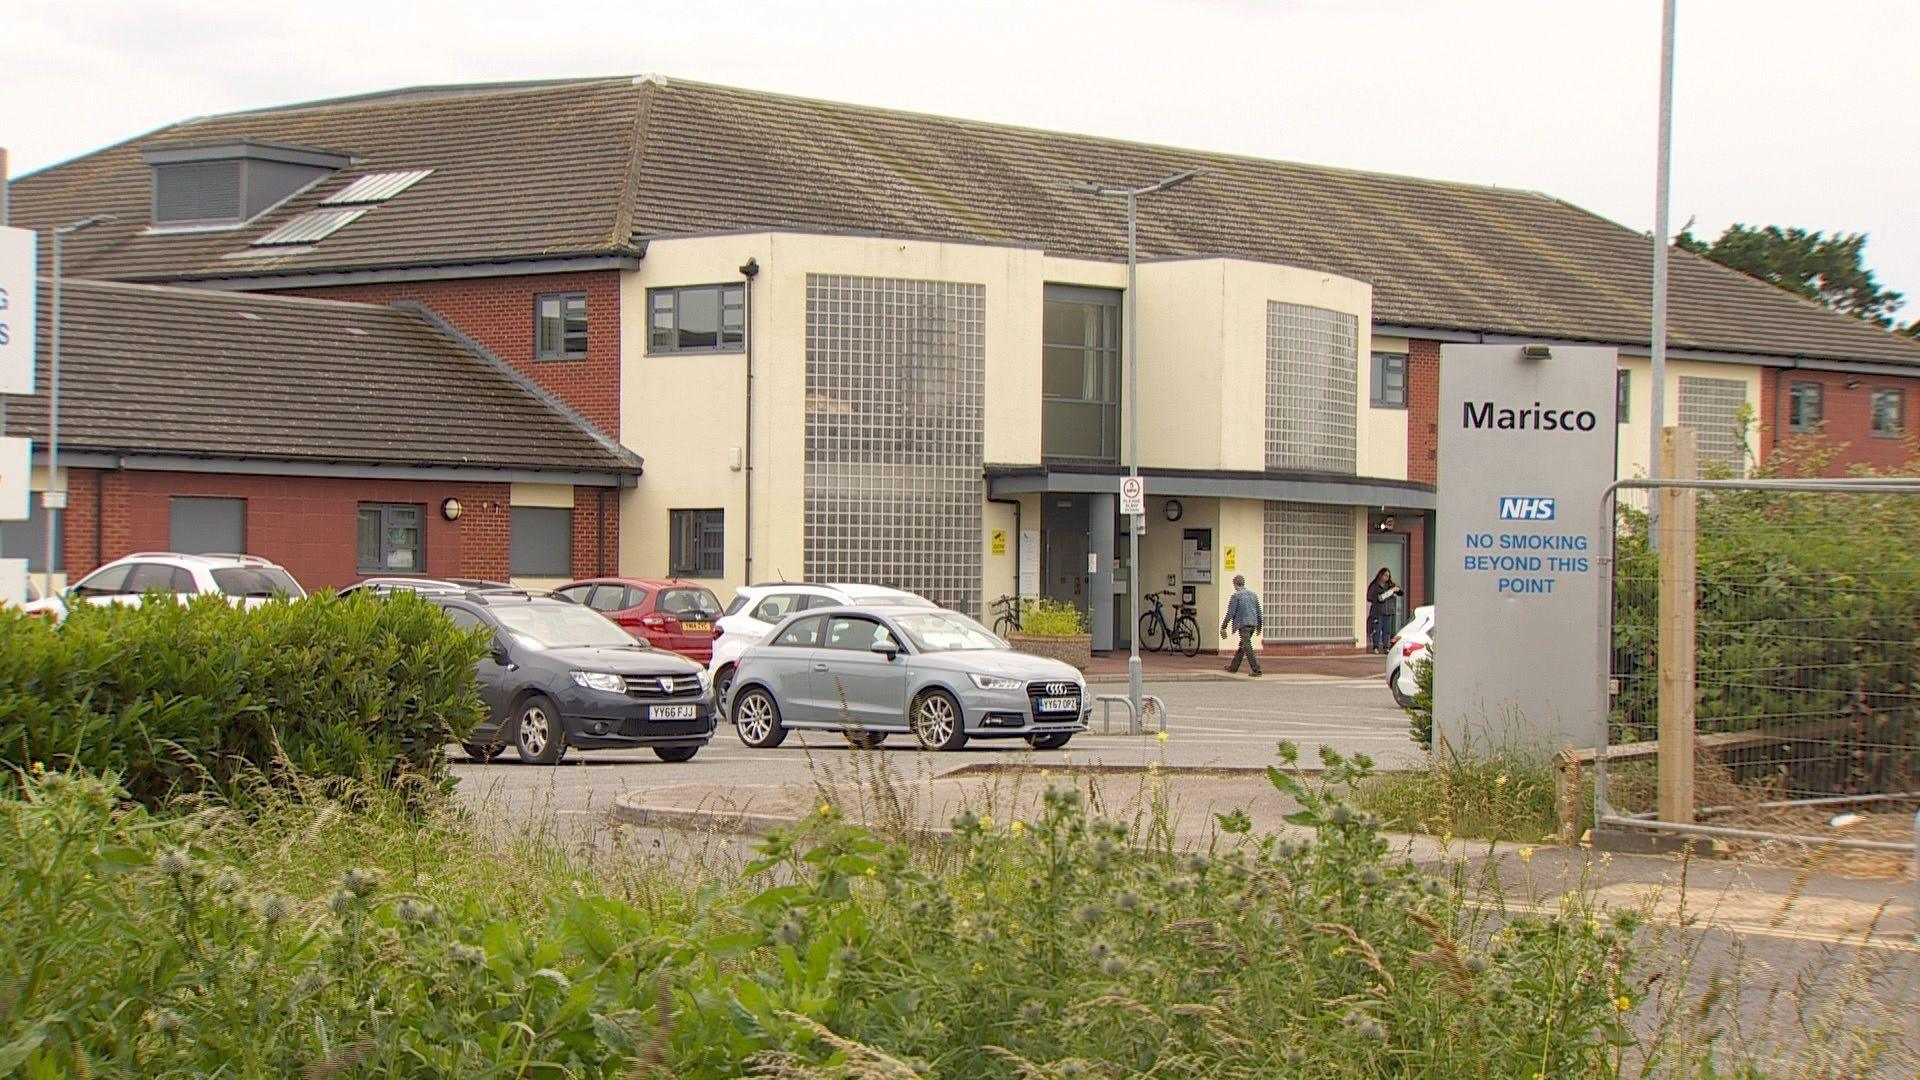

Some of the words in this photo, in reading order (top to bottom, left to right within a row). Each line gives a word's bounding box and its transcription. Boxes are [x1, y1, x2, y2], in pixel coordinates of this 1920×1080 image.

[1463, 401, 1597, 431] Marisco
[1500, 498, 1554, 519] NHS
[1466, 534, 1494, 549] NO
[1499, 534, 1588, 551] SMOKING
[1464, 556, 1542, 571] BEYOND
[1547, 556, 1589, 572] THIS
[1498, 578, 1556, 594] POINT
[653, 707, 676, 717] YY66
[677, 707, 693, 717] FJJ
[1044, 699, 1061, 709] YY67
